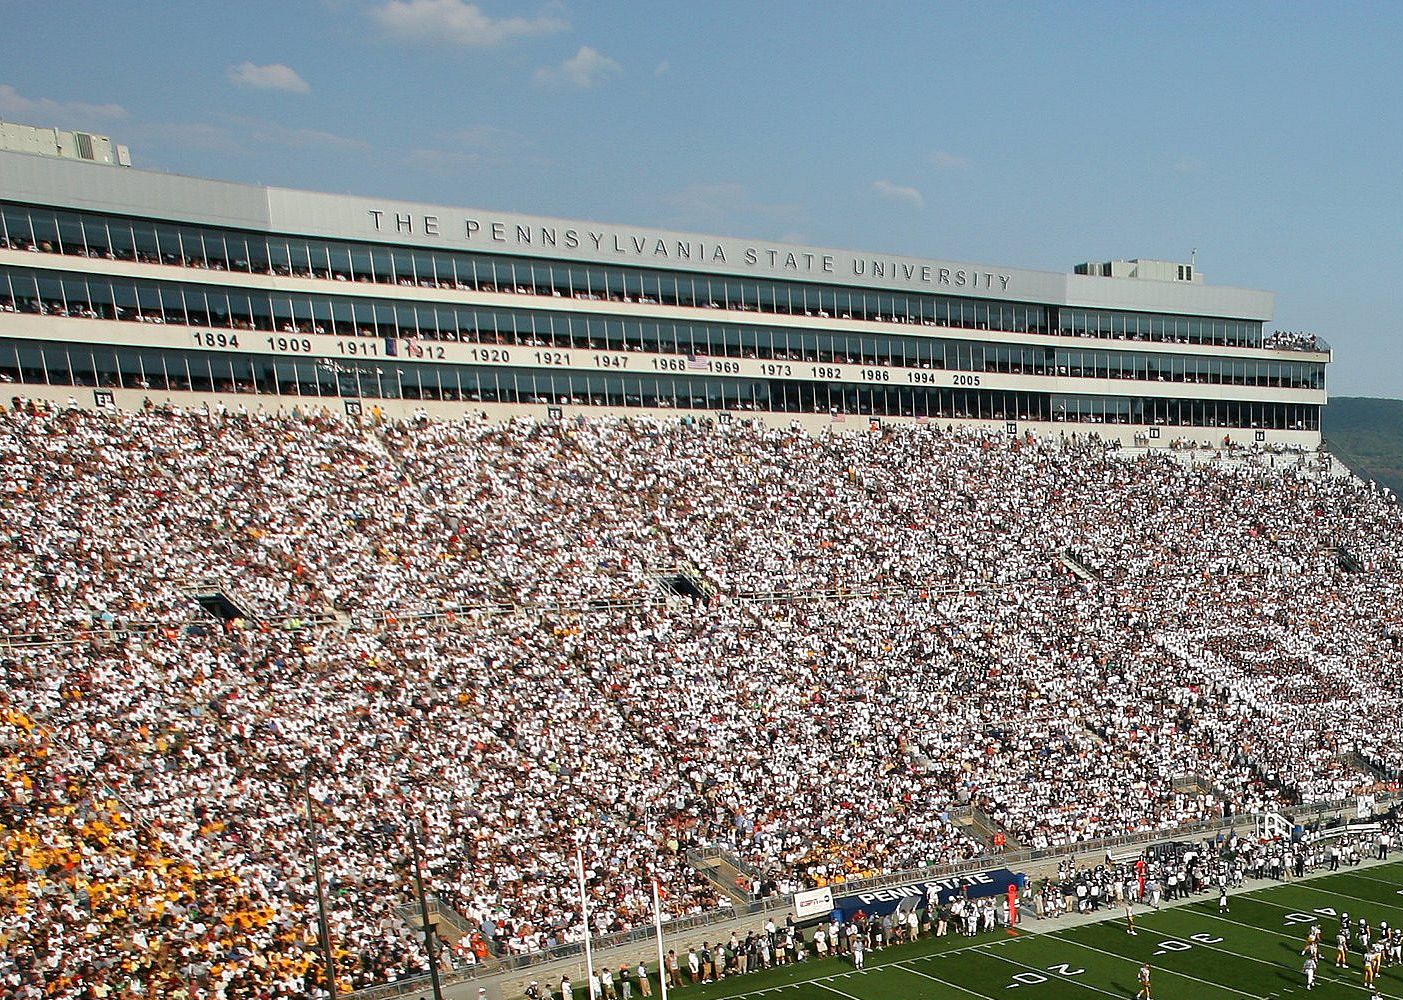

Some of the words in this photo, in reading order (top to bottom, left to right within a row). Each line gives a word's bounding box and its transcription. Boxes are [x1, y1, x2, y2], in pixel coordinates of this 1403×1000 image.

[368, 209, 442, 236] THE
[465, 218, 727, 264] PENNSYLVANIA
[745, 247, 835, 274] STATE
[853, 259, 1013, 292] UNIVERSITY
[194, 331, 240, 350] 1894
[266, 336, 312, 354] 1909
[337, 341, 379, 357] 1911
[405, 343, 446, 360] 1912
[471, 348, 511, 364] 1920
[534, 351, 572, 366] 1921
[592, 355, 629, 369] 1947
[651, 358, 687, 372] 1968
[707, 360, 741, 374] 1969
[760, 363, 792, 377] 1973
[811, 366, 842, 380] 1982
[860, 369, 890, 382] 1986
[907, 372, 936, 385] 1994
[953, 374, 981, 387] 2005
[857, 884, 923, 905] PENN
[1286, 906, 1338, 924] 40
[1156, 933, 1224, 954] 30
[1011, 962, 1086, 986] 20
